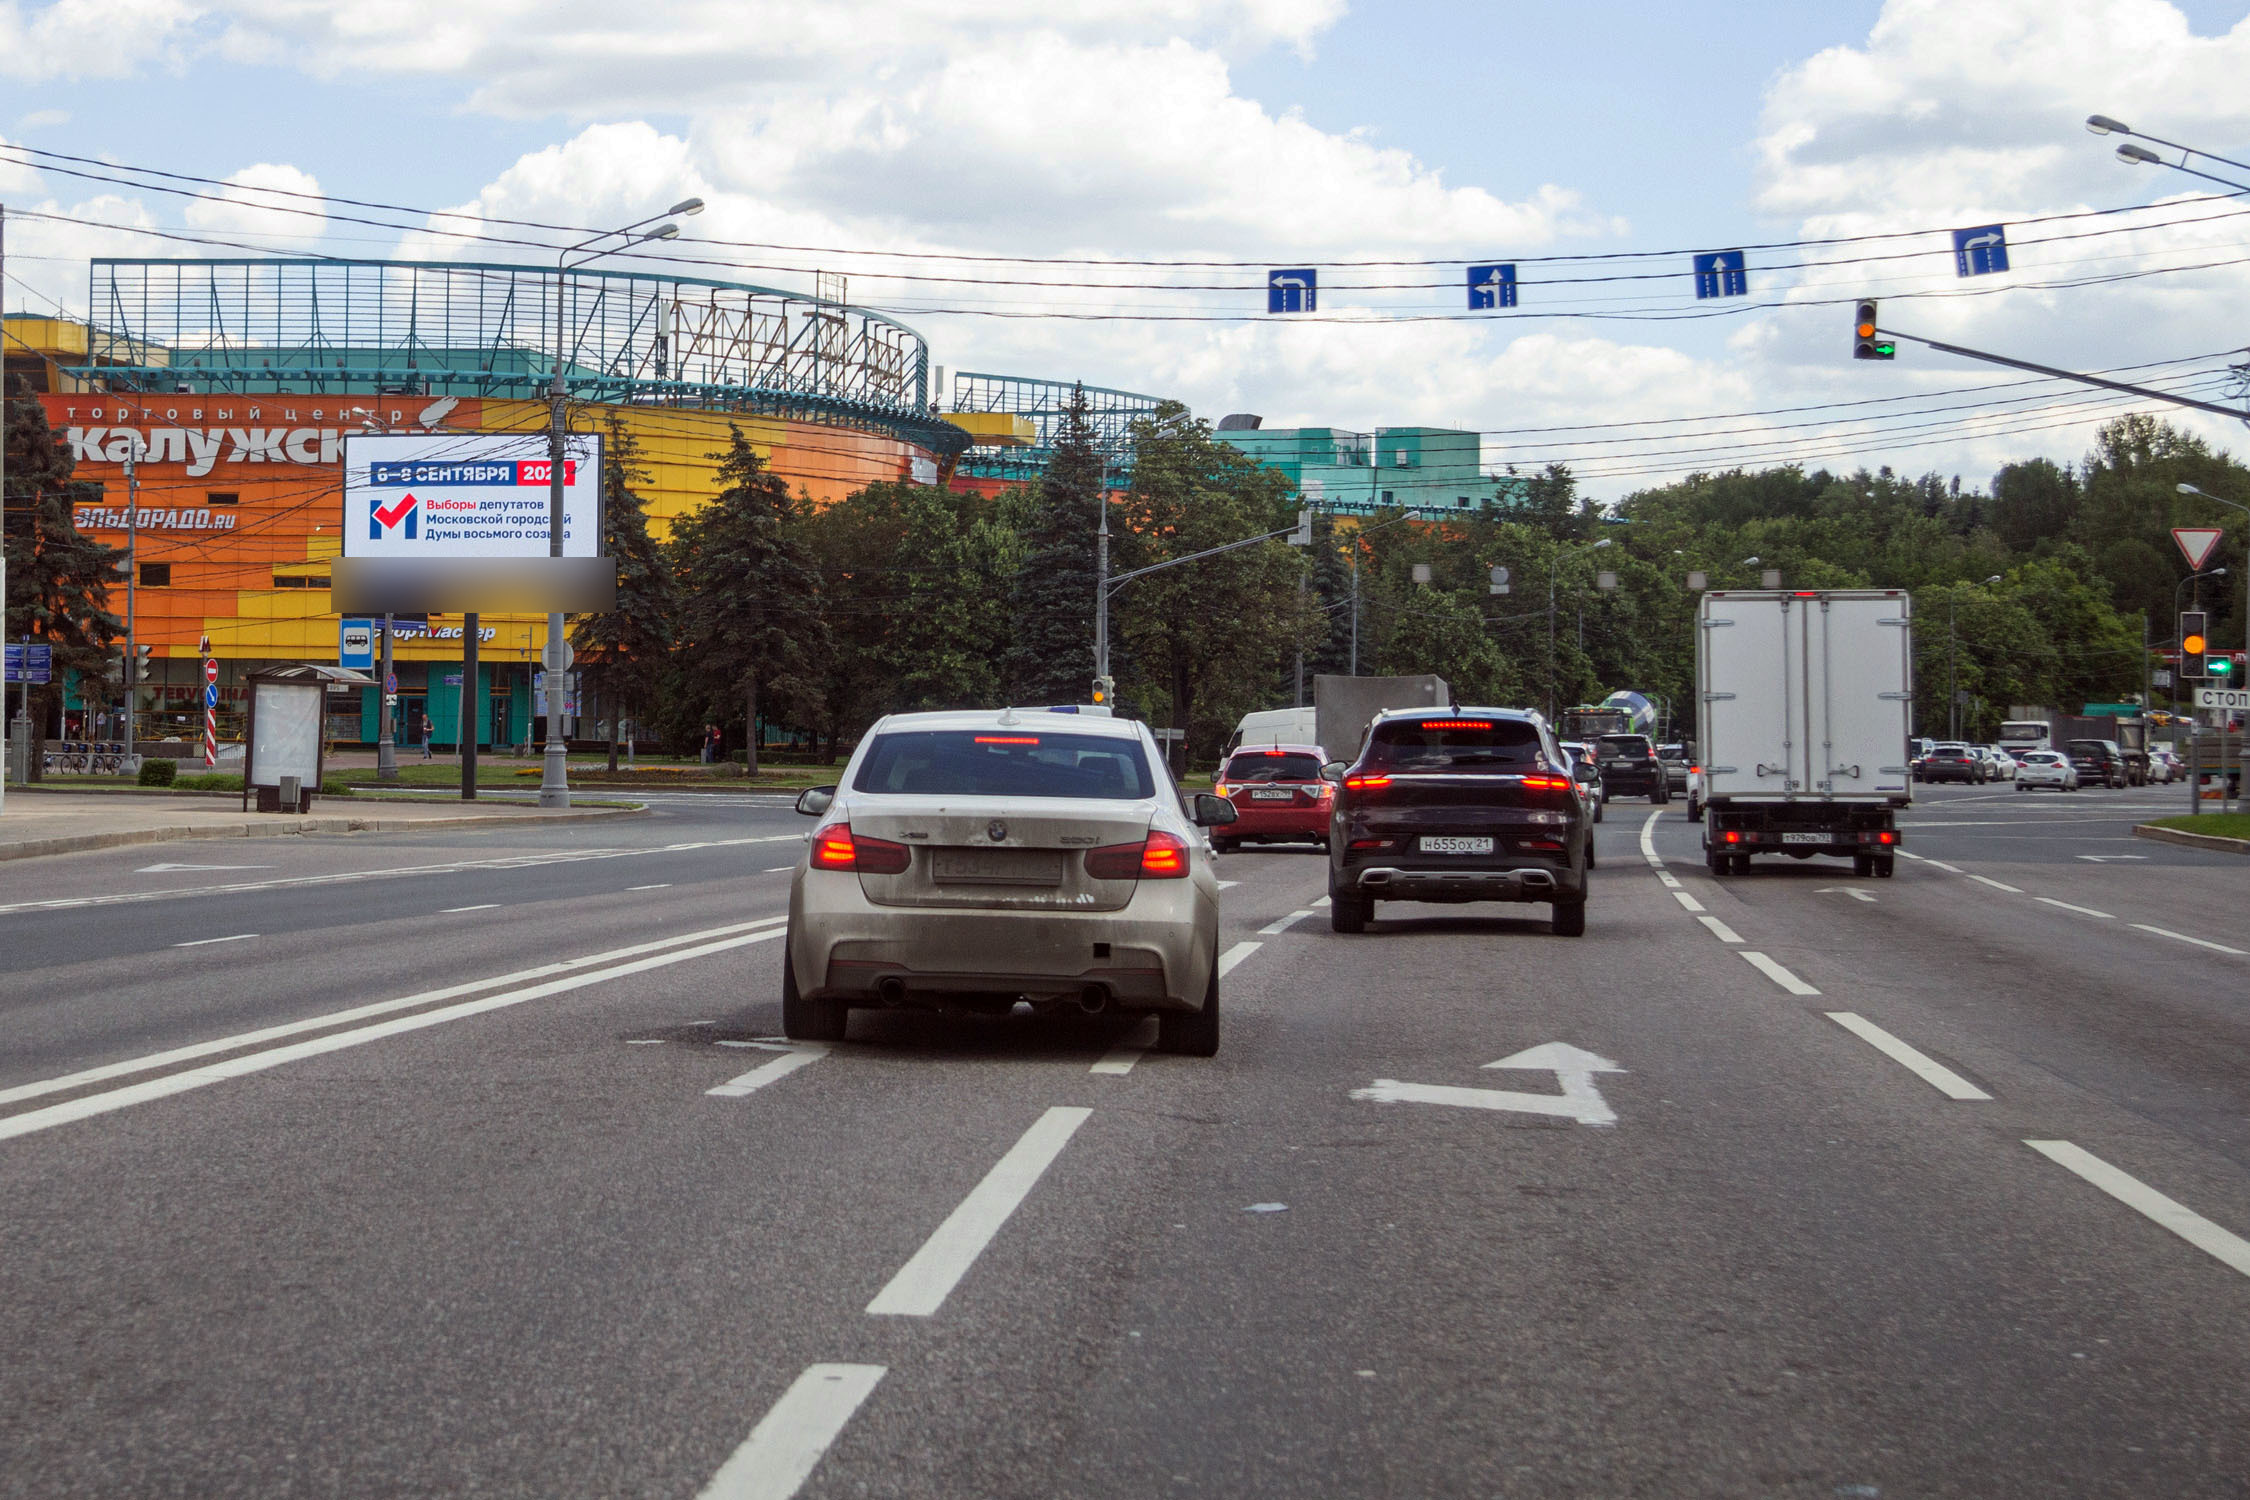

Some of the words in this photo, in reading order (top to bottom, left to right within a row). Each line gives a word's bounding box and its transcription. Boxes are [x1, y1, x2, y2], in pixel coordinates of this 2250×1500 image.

[67, 406, 261, 423] торговый
[415, 466, 510, 481] СЕНТЯБРЯ
[523, 465, 567, 481] 202
[426, 500, 477, 511] Выборы
[479, 500, 545, 513] депутатов
[426, 513, 503, 526] Московской
[506, 513, 571, 526] городсй
[425, 529, 461, 541] Думы
[464, 530, 522, 540] восьмого
[2203, 691, 2248, 706] СТОП
[1476, 838, 1490, 849] 21
